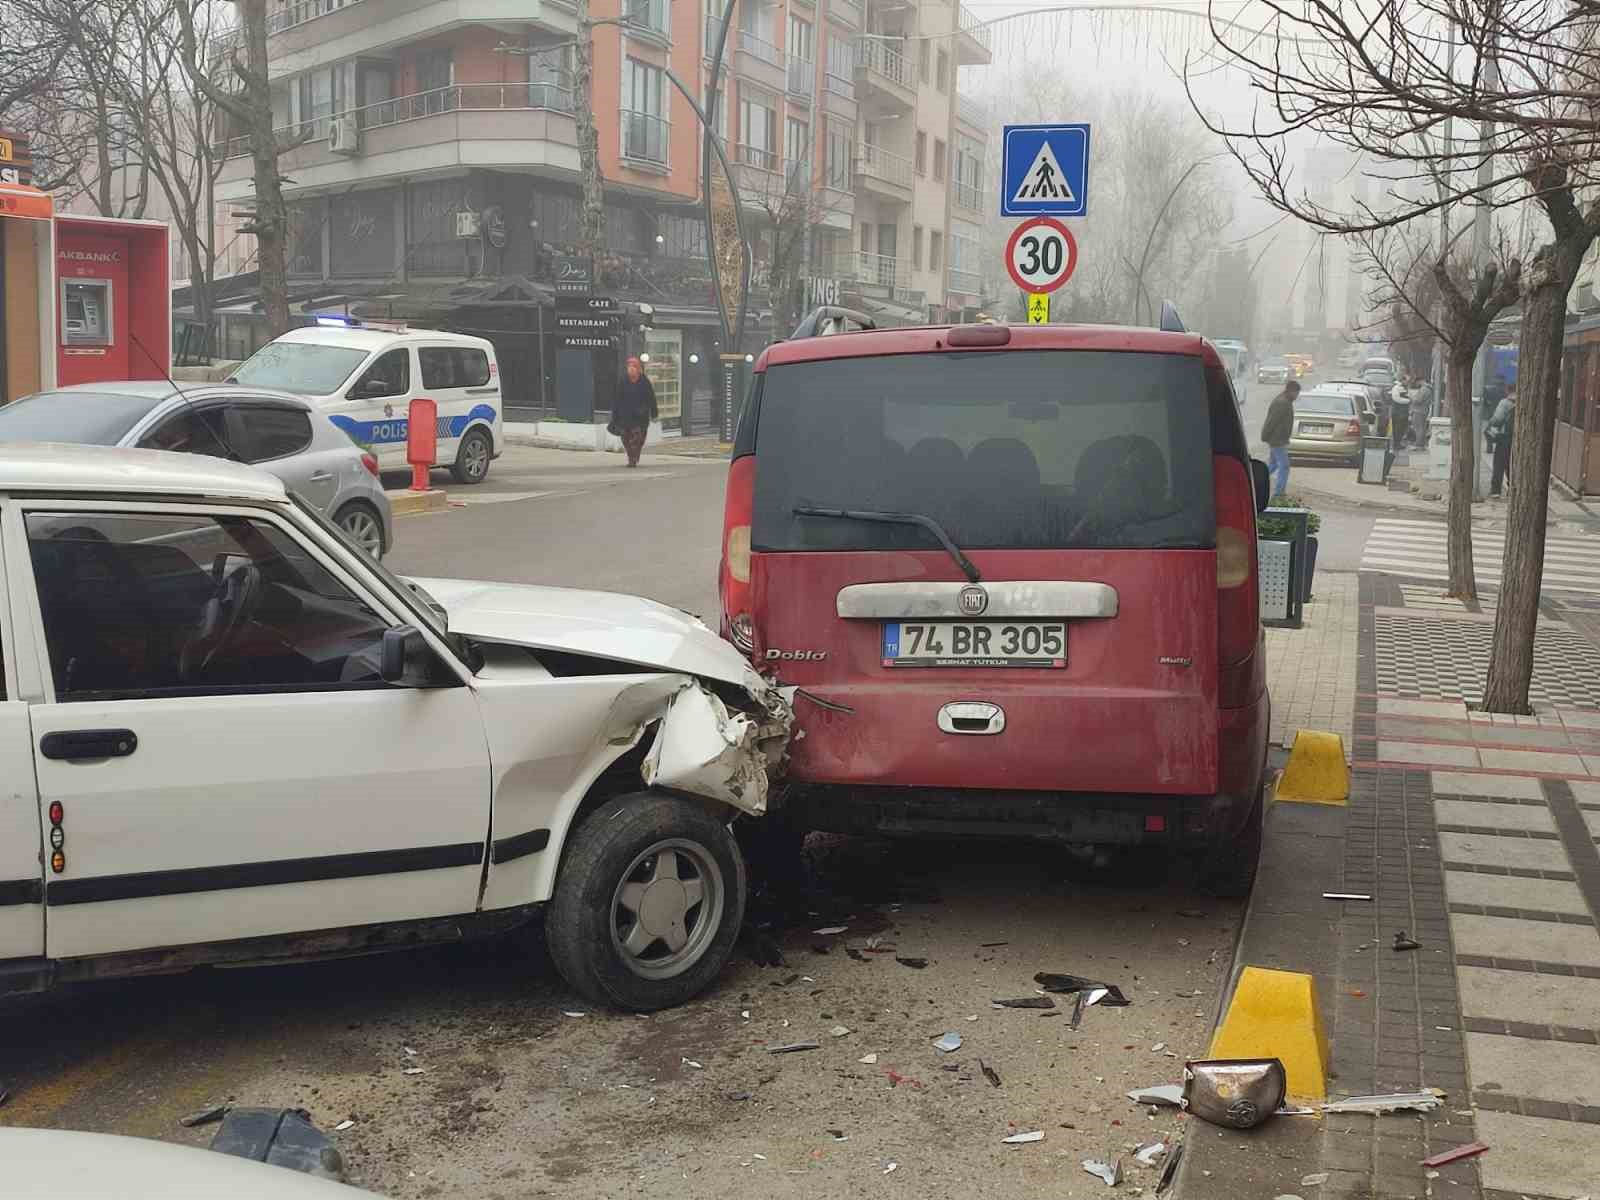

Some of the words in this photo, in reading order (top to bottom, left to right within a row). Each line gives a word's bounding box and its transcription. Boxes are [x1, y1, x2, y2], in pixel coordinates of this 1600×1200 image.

[60, 250, 111, 261] AKBANK
[1020, 236, 1062, 275] 30
[588, 300, 609, 308] CAFE
[559, 319, 609, 328] RESTAURANT
[565, 338, 609, 347] PATISSERIE
[964, 594, 983, 609] FIAT
[905, 626, 944, 655] 74
[952, 626, 992, 655] BR
[1001, 626, 1062, 655] 305
[887, 644, 898, 652] TR
